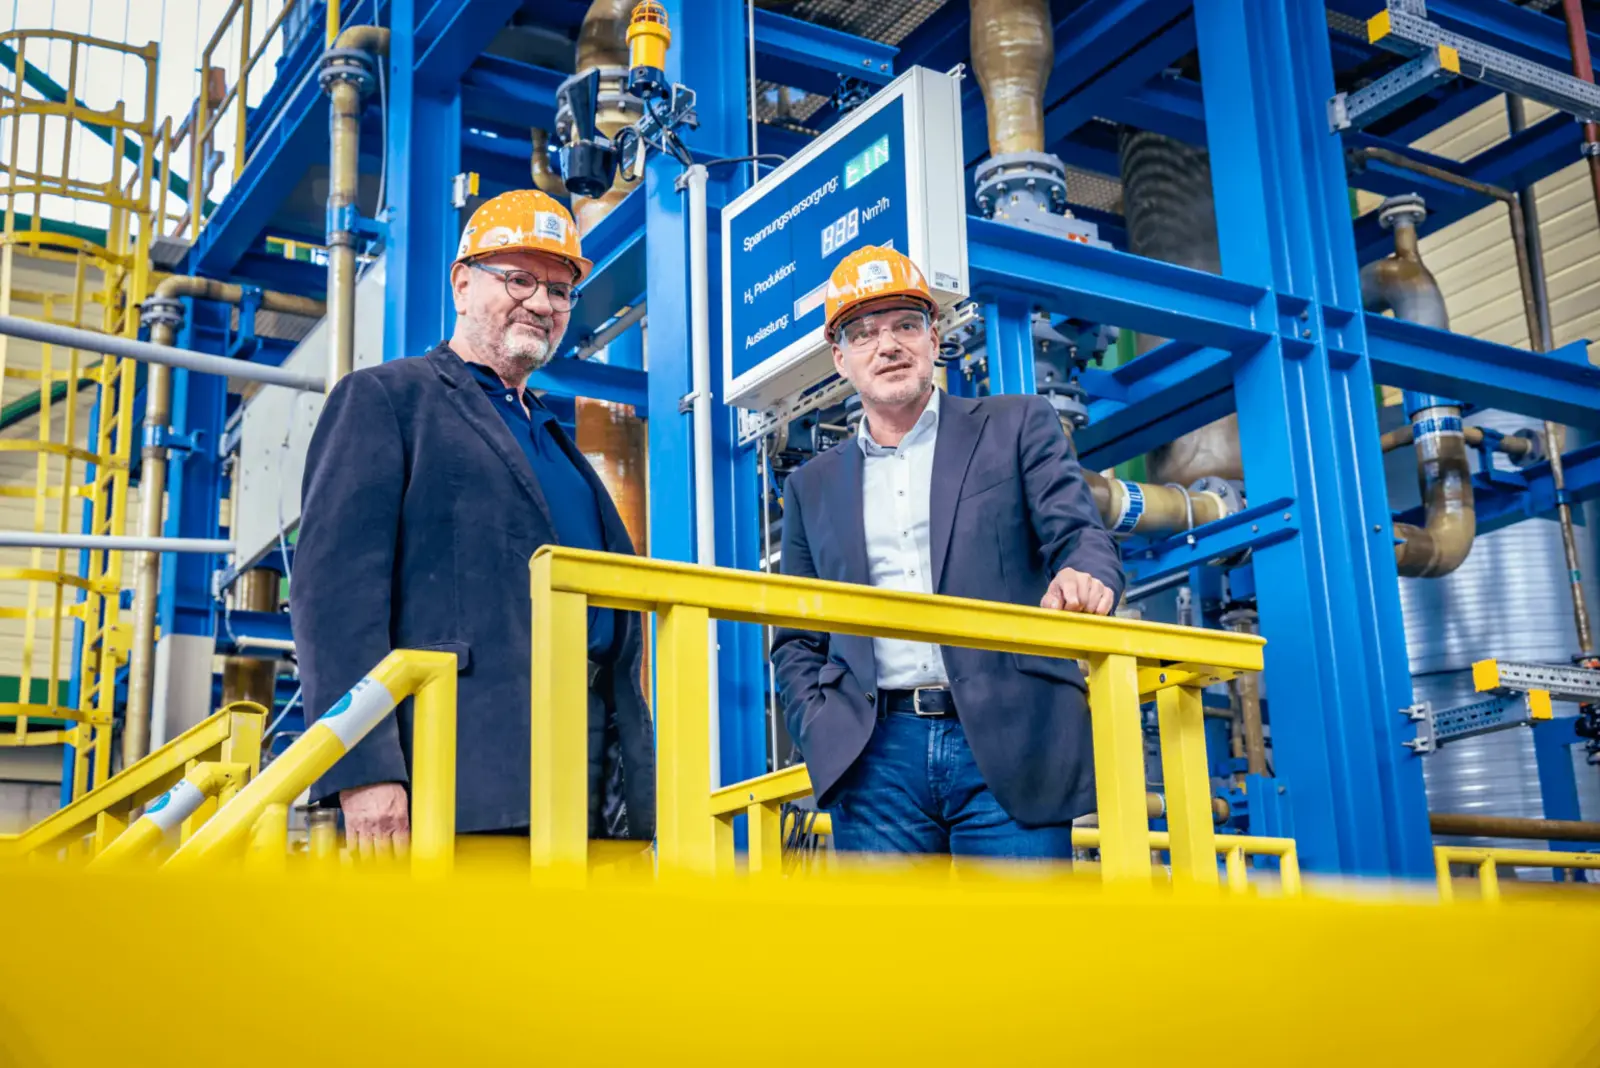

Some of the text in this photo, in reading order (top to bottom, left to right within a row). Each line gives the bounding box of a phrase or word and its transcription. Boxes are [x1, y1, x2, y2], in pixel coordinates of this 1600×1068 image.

[743, 176, 838, 252] Spannungsversorgung:
[754, 261, 796, 297] Produktion:
[745, 314, 788, 349] Auslastung:
